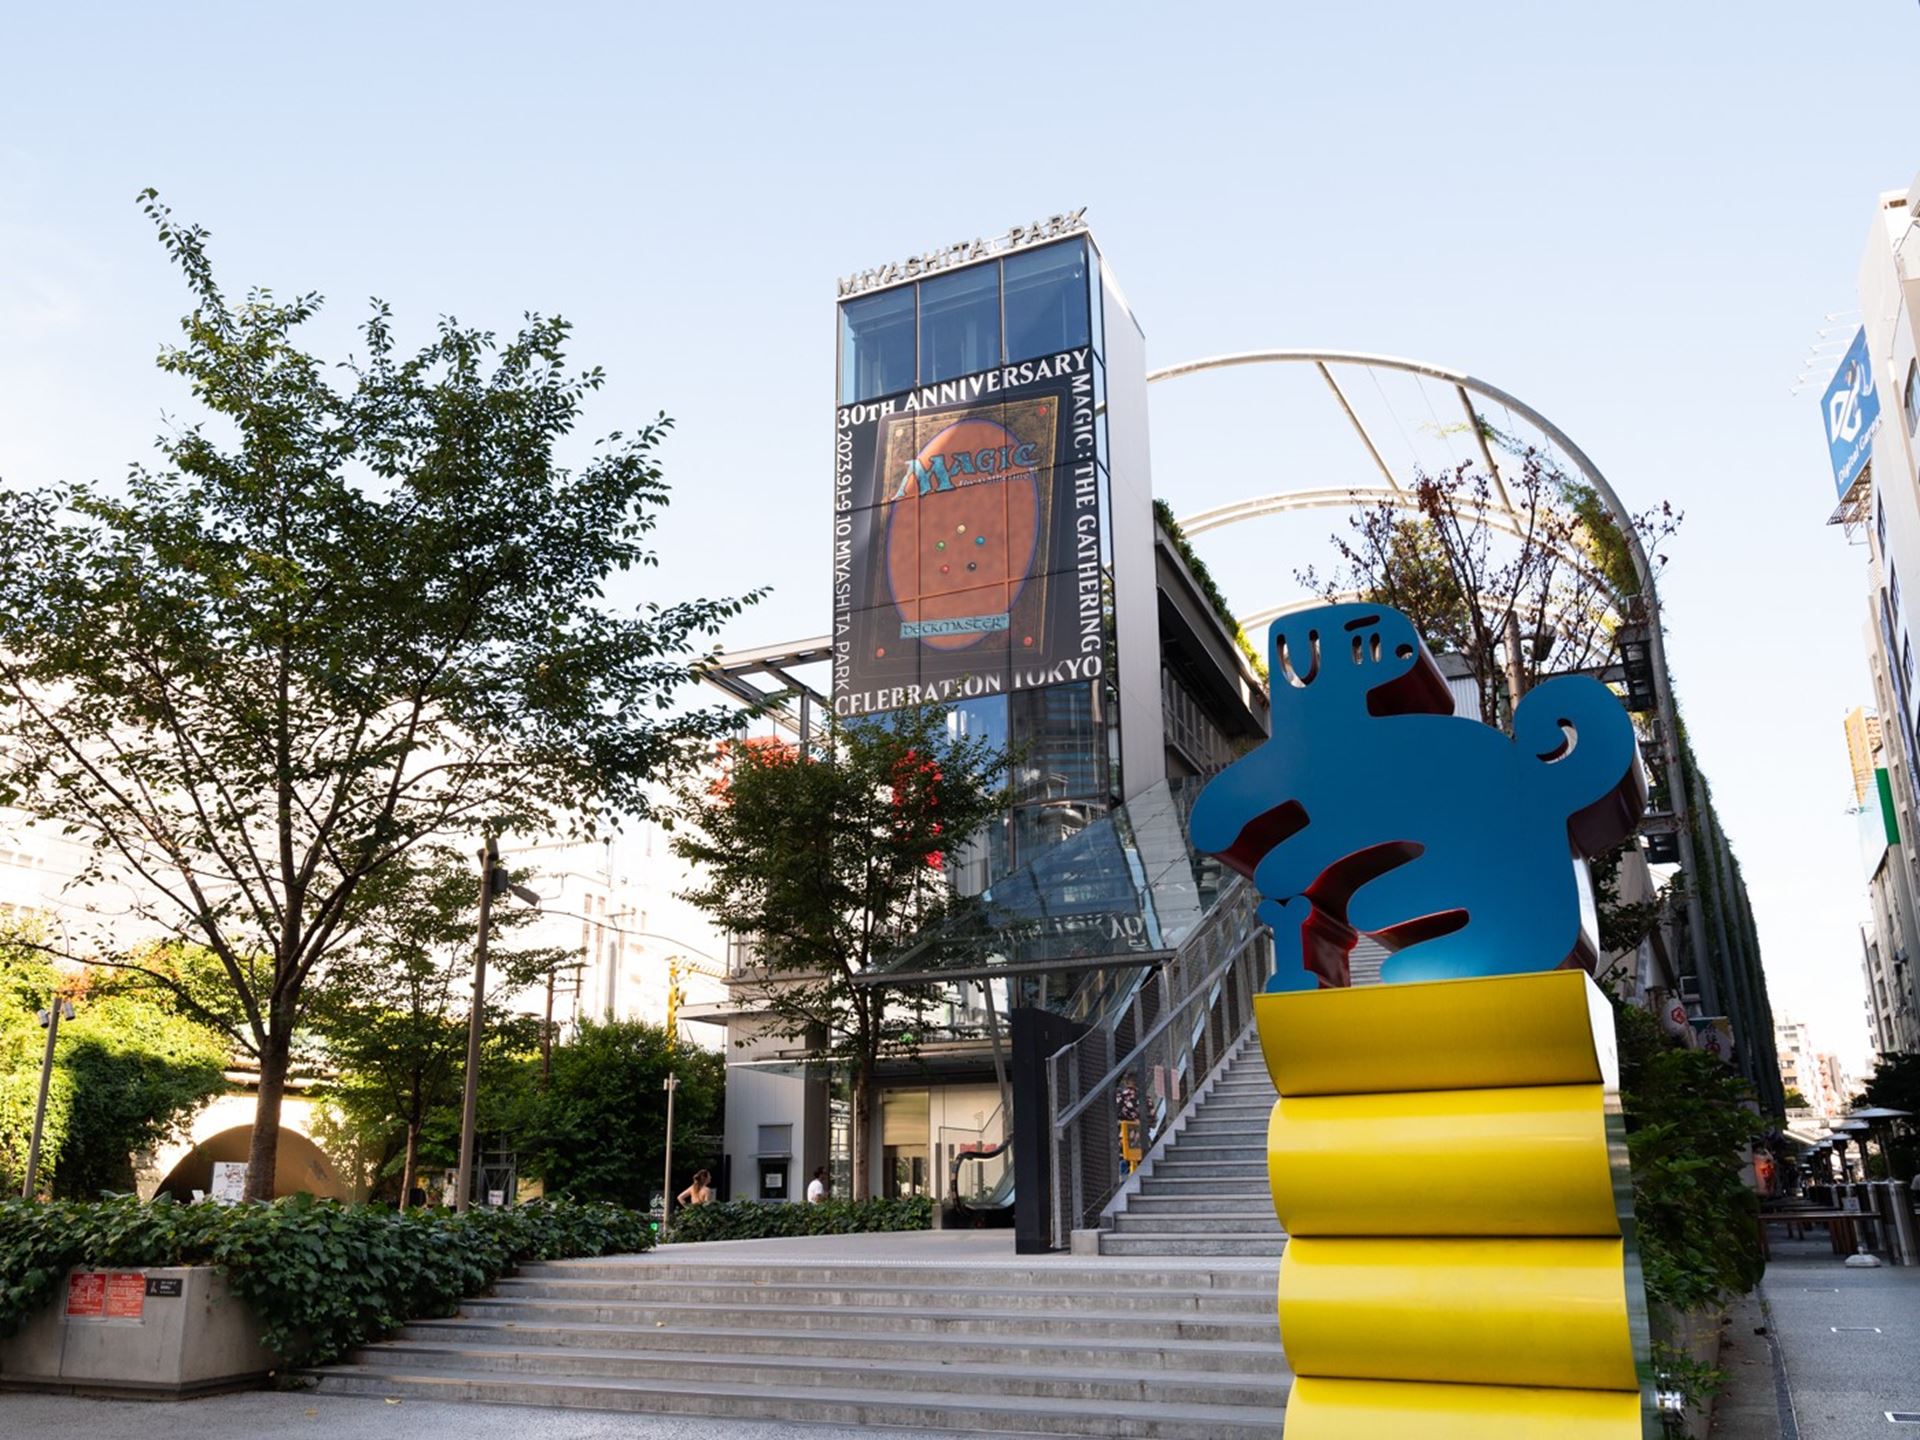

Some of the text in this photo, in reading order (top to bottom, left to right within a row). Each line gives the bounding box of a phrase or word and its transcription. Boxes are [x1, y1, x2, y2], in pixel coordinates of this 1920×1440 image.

[837, 206, 1088, 298] MIYASHITA PARK
[838, 348, 1089, 429] 30TH ANNIVERSARY
[1075, 462, 1097, 509] THE
[836, 540, 852, 637] MIYASHITA
[1077, 514, 1101, 653] GATHERING
[835, 641, 851, 692] PARK
